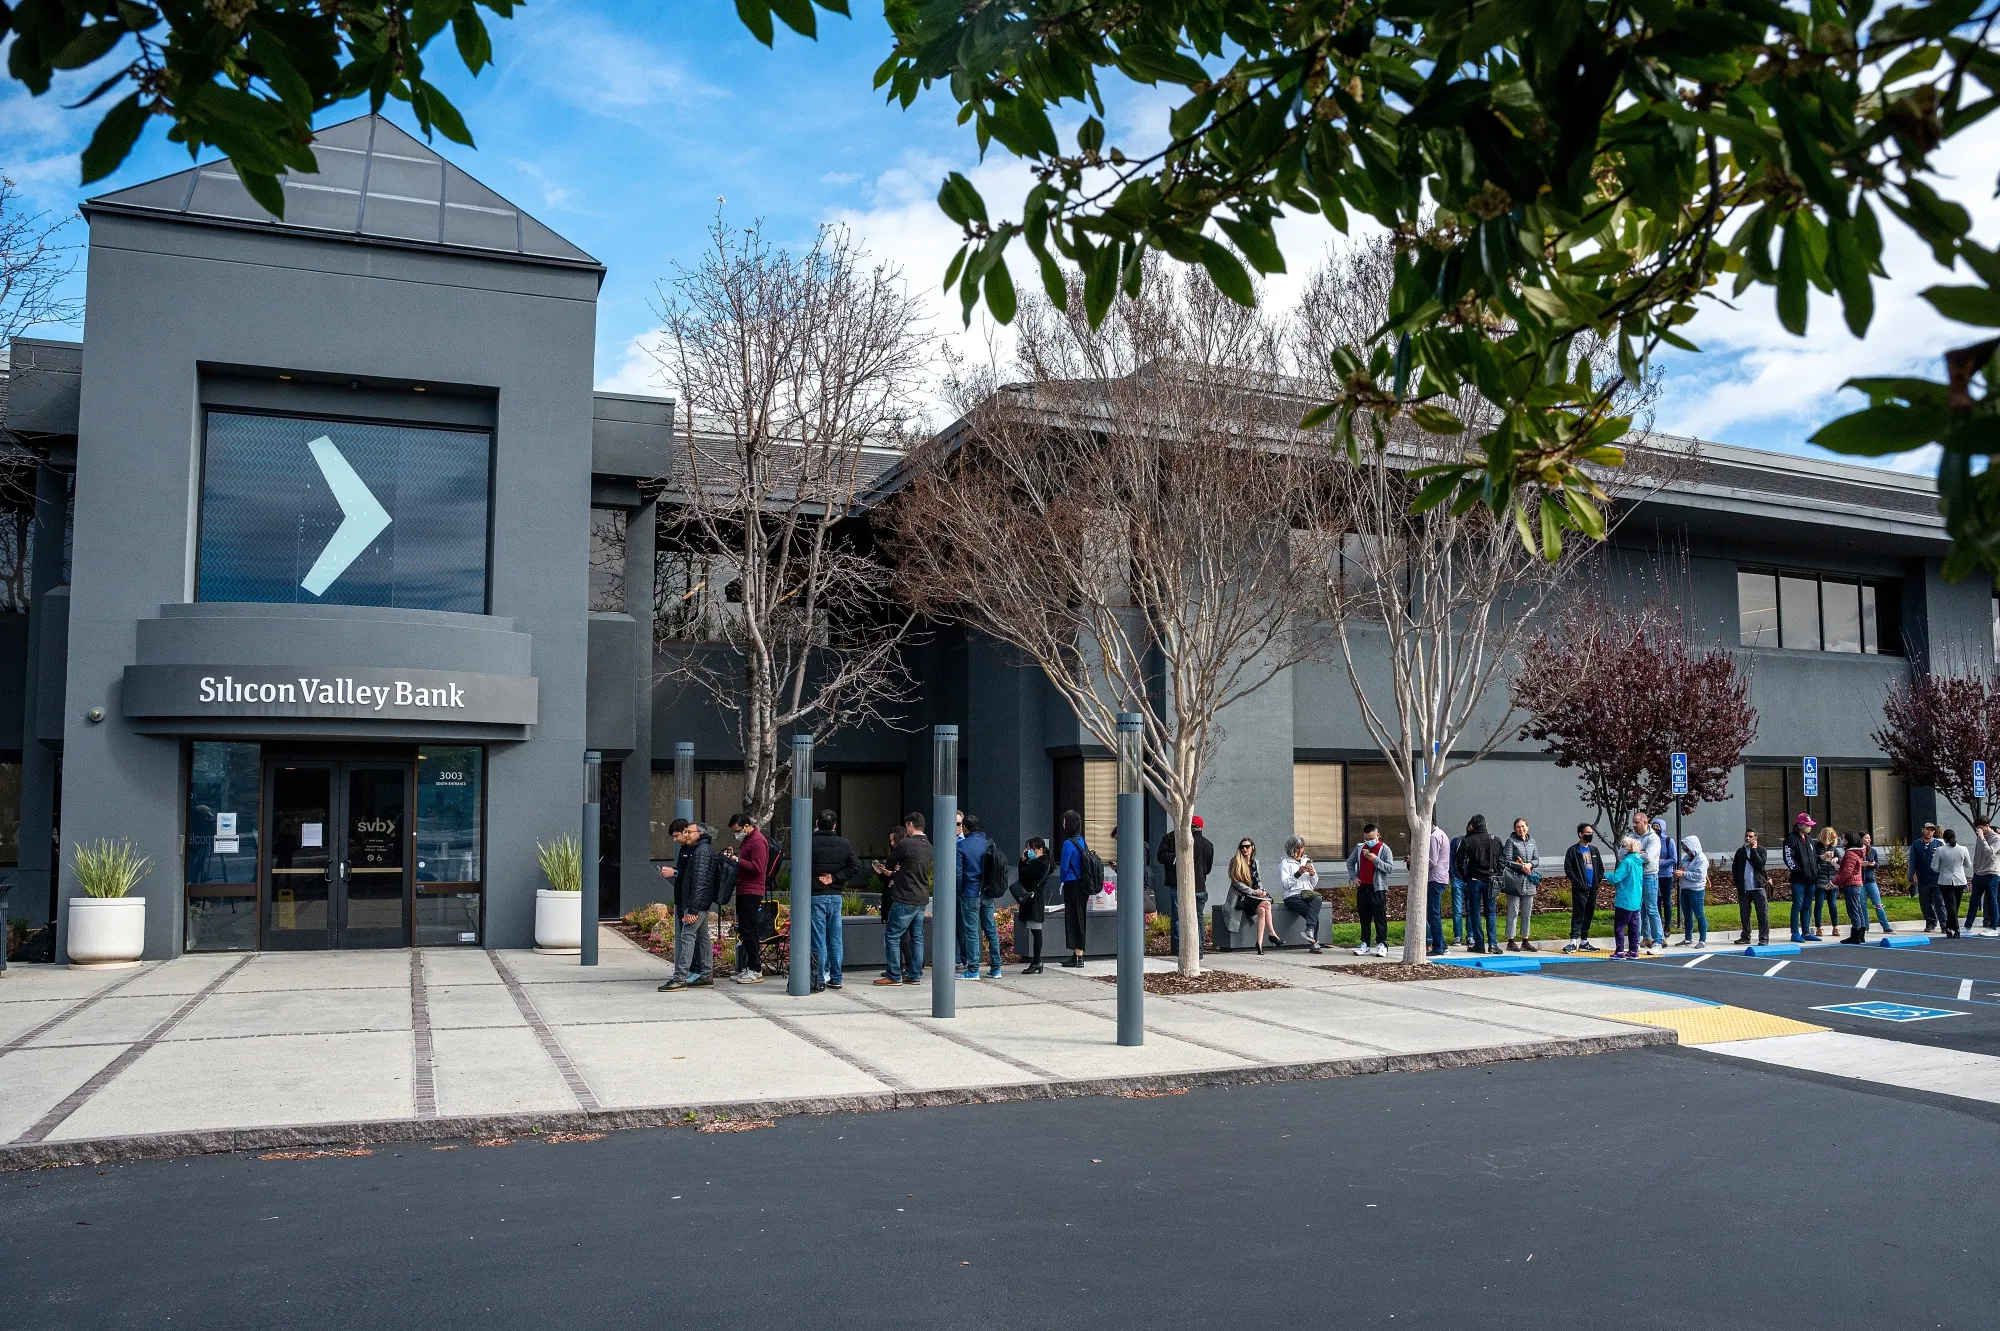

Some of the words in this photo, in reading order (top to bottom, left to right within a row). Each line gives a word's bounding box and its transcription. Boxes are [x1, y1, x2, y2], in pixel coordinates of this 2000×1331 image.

[199, 676, 297, 703] Silicon
[298, 678, 390, 711] Valley
[394, 681, 465, 708] Bank
[439, 771, 463, 780] 3003
[357, 817, 387, 832] svb
[188, 833, 214, 845] elcom
